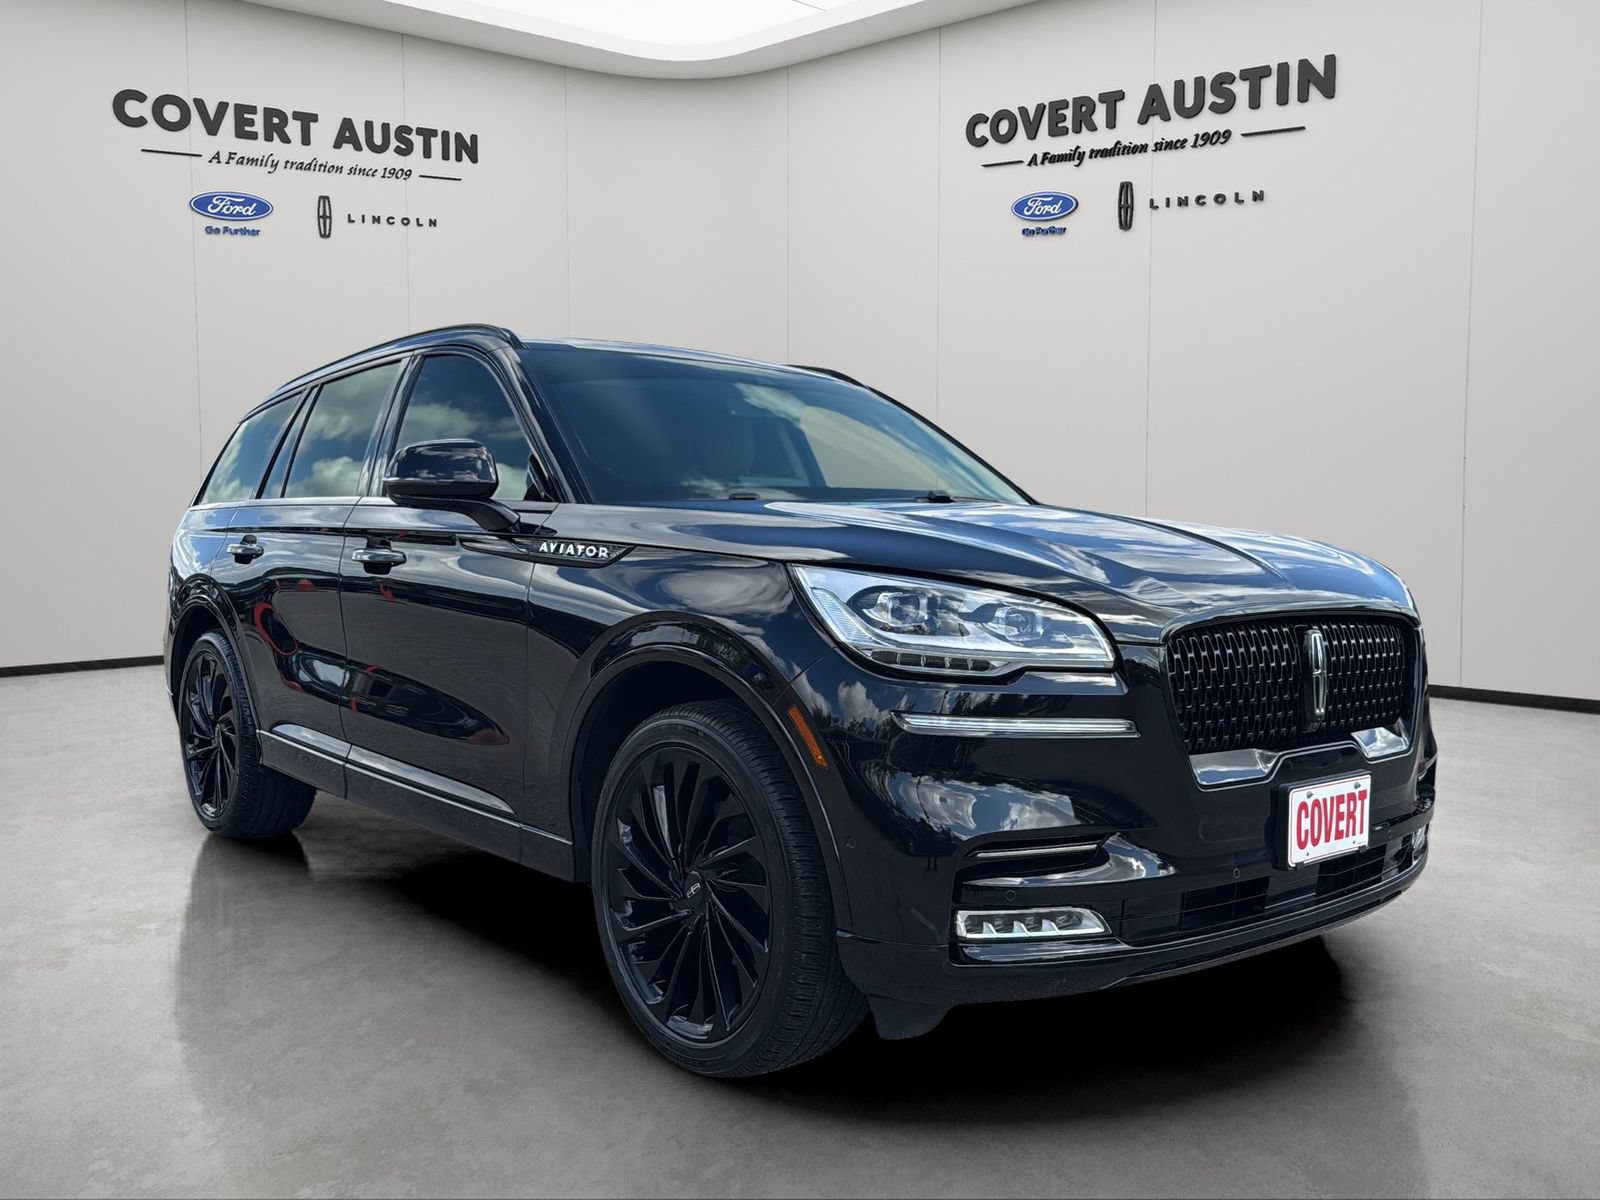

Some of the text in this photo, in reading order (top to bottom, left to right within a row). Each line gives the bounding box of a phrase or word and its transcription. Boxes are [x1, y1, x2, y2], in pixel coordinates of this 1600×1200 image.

[966, 53, 1336, 148] COVERT AUSTIN
[112, 88, 479, 164] COVERT AUSTIN
[1027, 129, 1233, 168] A Family tradition since 1909
[208, 151, 413, 181] A Family tradition since 1909
[207, 195, 257, 216] Ford
[1023, 196, 1063, 215] Ford
[1149, 190, 1265, 210] LINCOLN
[347, 213, 438, 228] LINCOLN
[204, 226, 261, 237] Go Further
[539, 541, 608, 558] AVIATOR
[1296, 789, 1368, 850] COVERT
